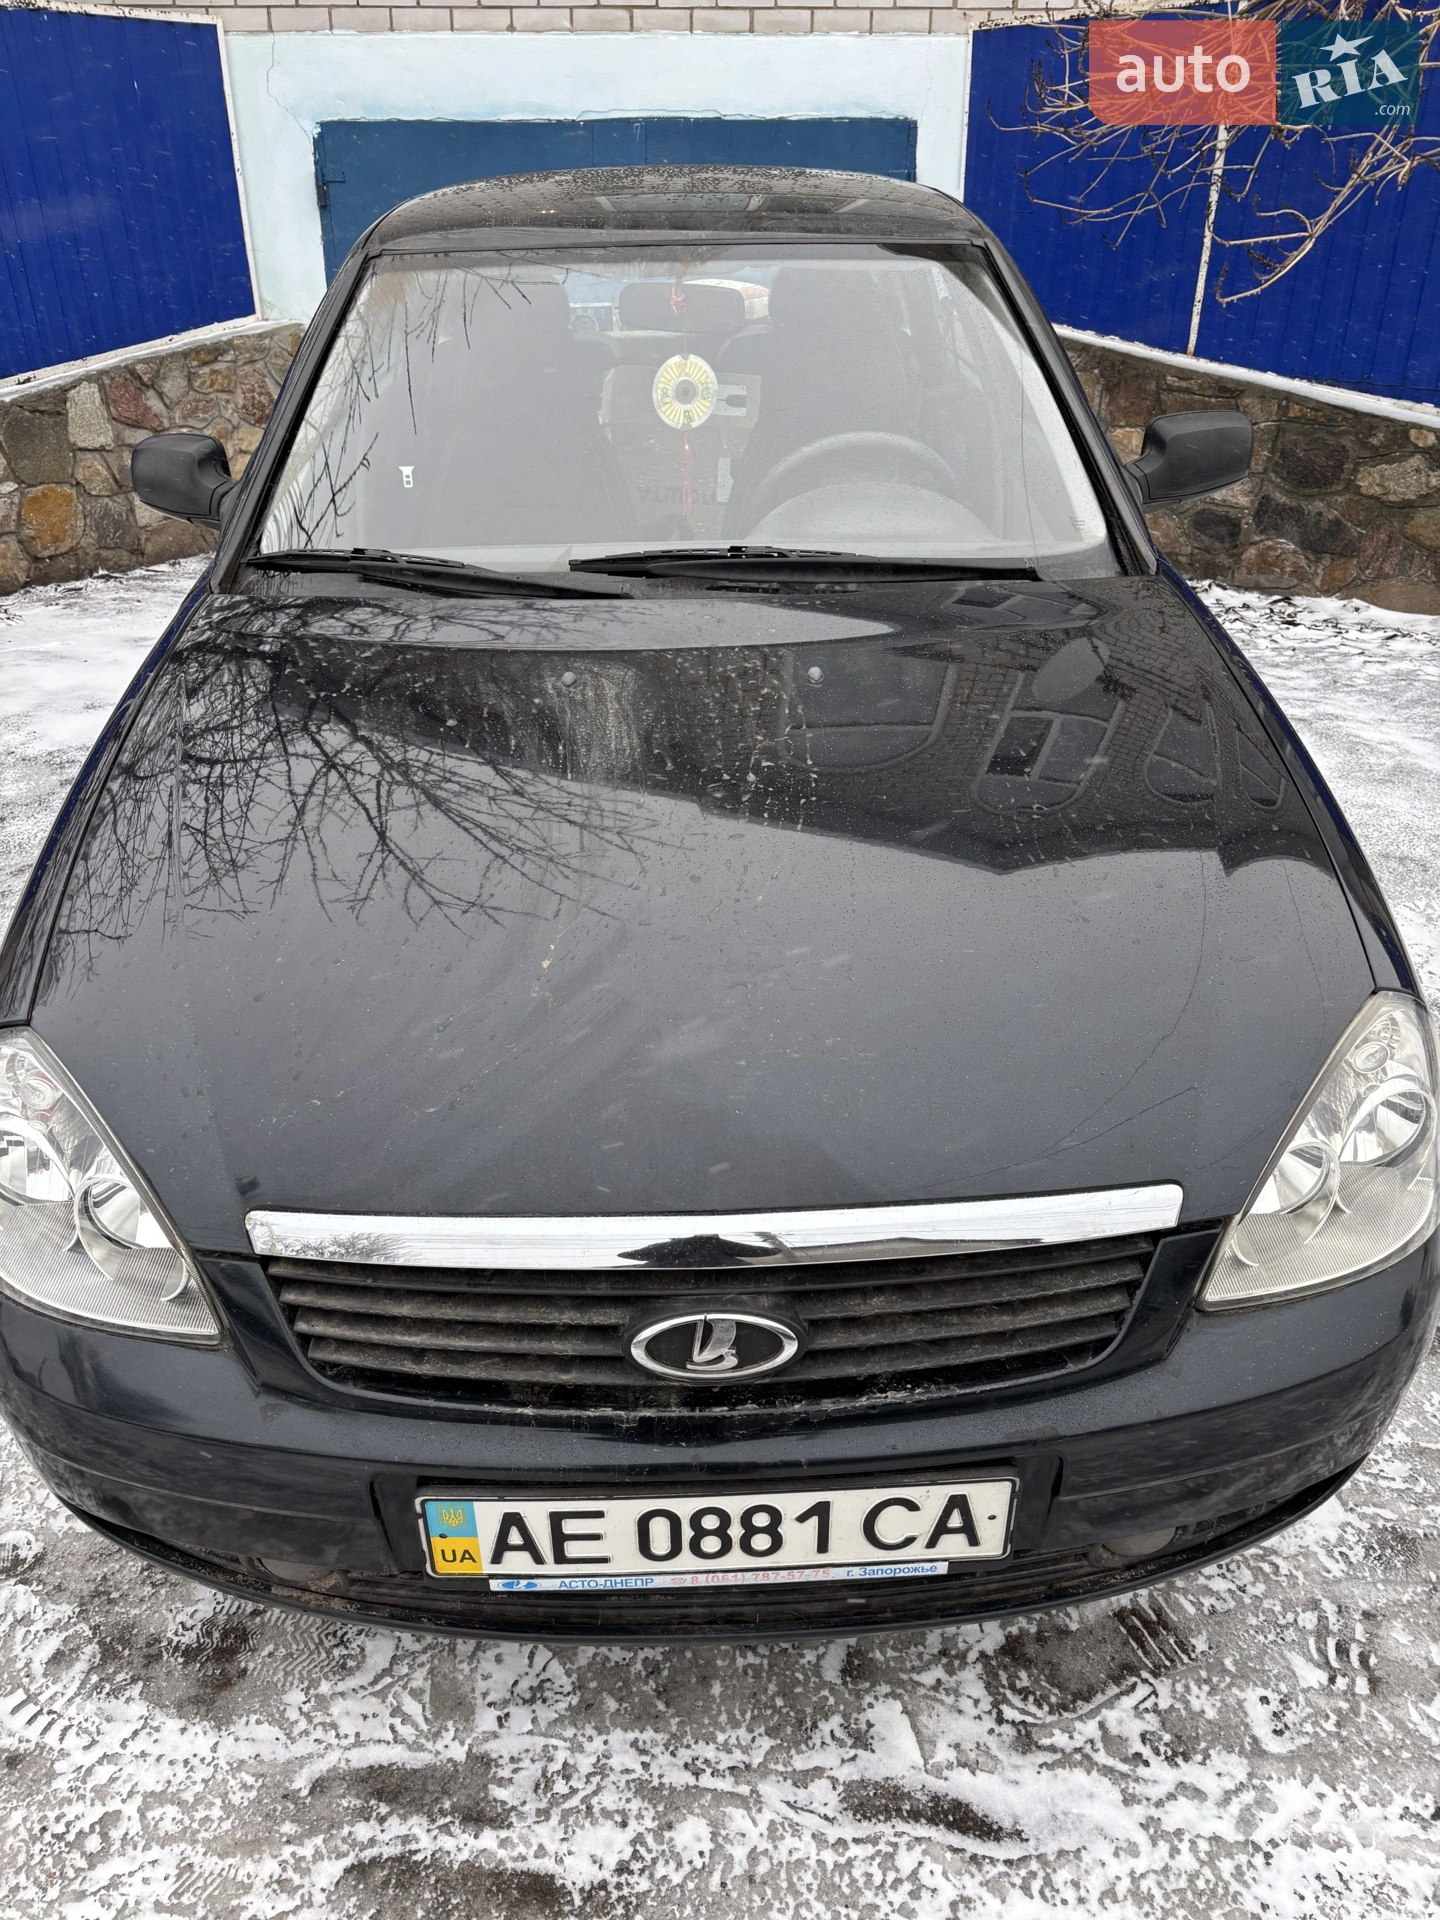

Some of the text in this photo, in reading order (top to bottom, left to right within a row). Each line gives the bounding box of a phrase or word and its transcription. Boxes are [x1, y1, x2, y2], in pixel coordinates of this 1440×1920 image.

[489, 1492, 981, 1565] AE 0881 CA
[440, 1548, 477, 1564] UA
[558, 1563, 938, 1590] АСТО-ДНЕПР 8 (061) 787-57-75 г. Запорожье
